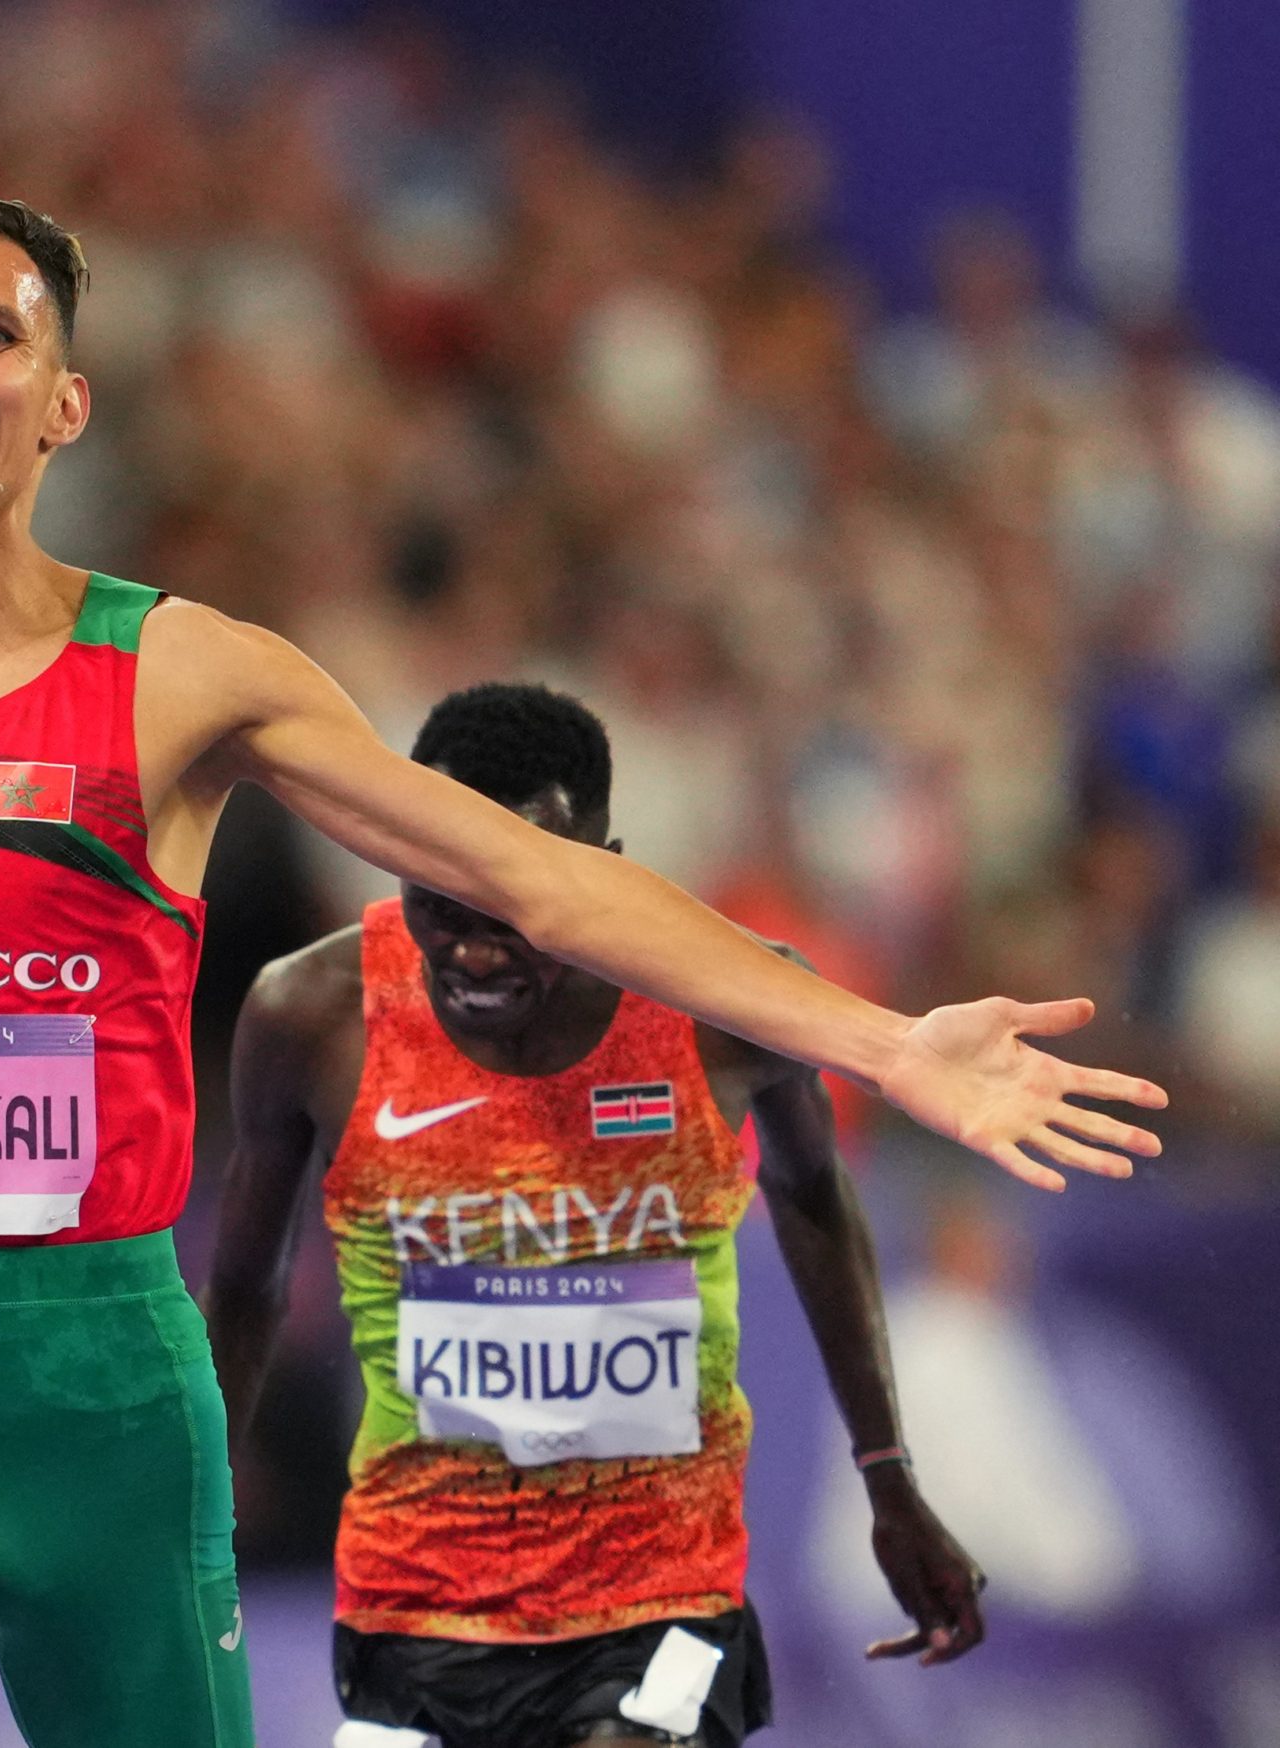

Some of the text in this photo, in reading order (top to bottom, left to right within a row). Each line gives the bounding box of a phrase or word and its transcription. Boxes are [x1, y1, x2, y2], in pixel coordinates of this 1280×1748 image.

[386, 1184, 688, 1267] KENYA
[475, 1276, 624, 1297] PARIS 2024
[413, 1329, 691, 1400] KIBIWOT
